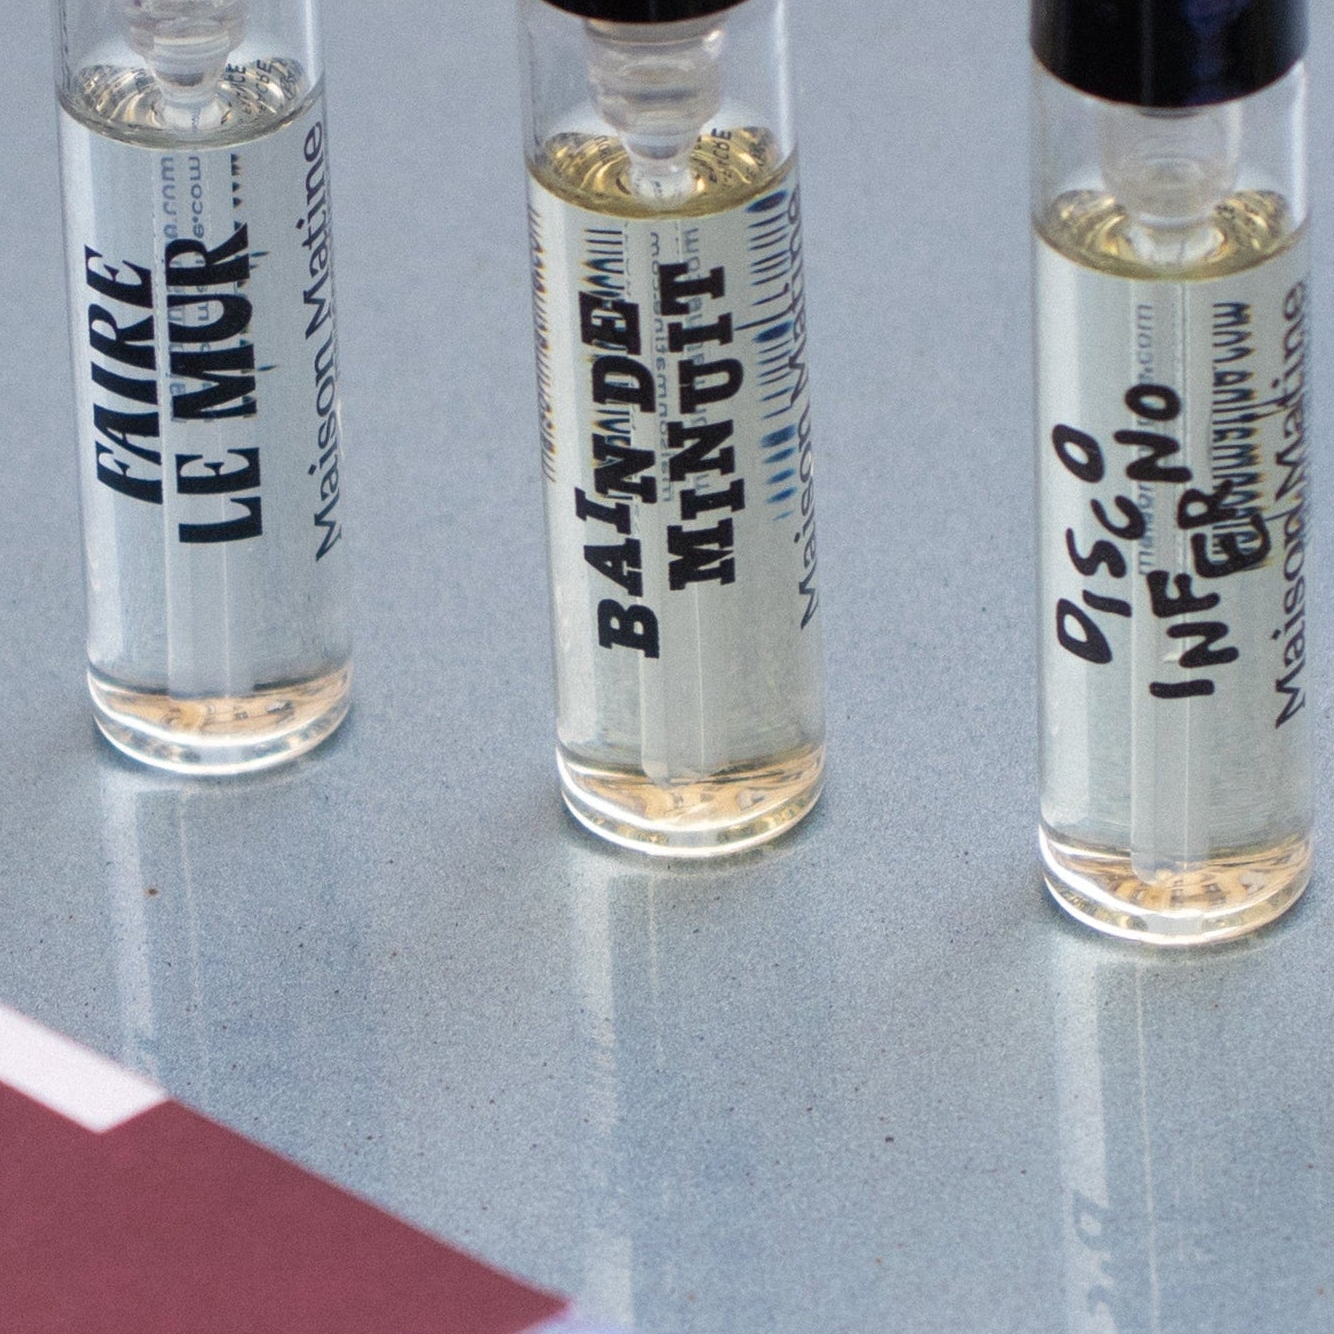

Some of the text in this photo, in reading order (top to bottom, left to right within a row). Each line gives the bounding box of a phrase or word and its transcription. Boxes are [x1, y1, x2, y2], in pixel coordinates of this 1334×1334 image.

[84, 244, 164, 505] FAIRE
[164, 221, 264, 545] LE MUR
[302, 120, 345, 562] Maison Matine
[578, 289, 657, 414] DE
[656, 261, 747, 592] MINUIT
[575, 433, 661, 660] BAIN
[793, 400, 820, 629] Maison
[1051, 423, 1148, 665] DISCO
[1112, 382, 1273, 700] INFERNO
[1270, 280, 1308, 730] Maison Matine
